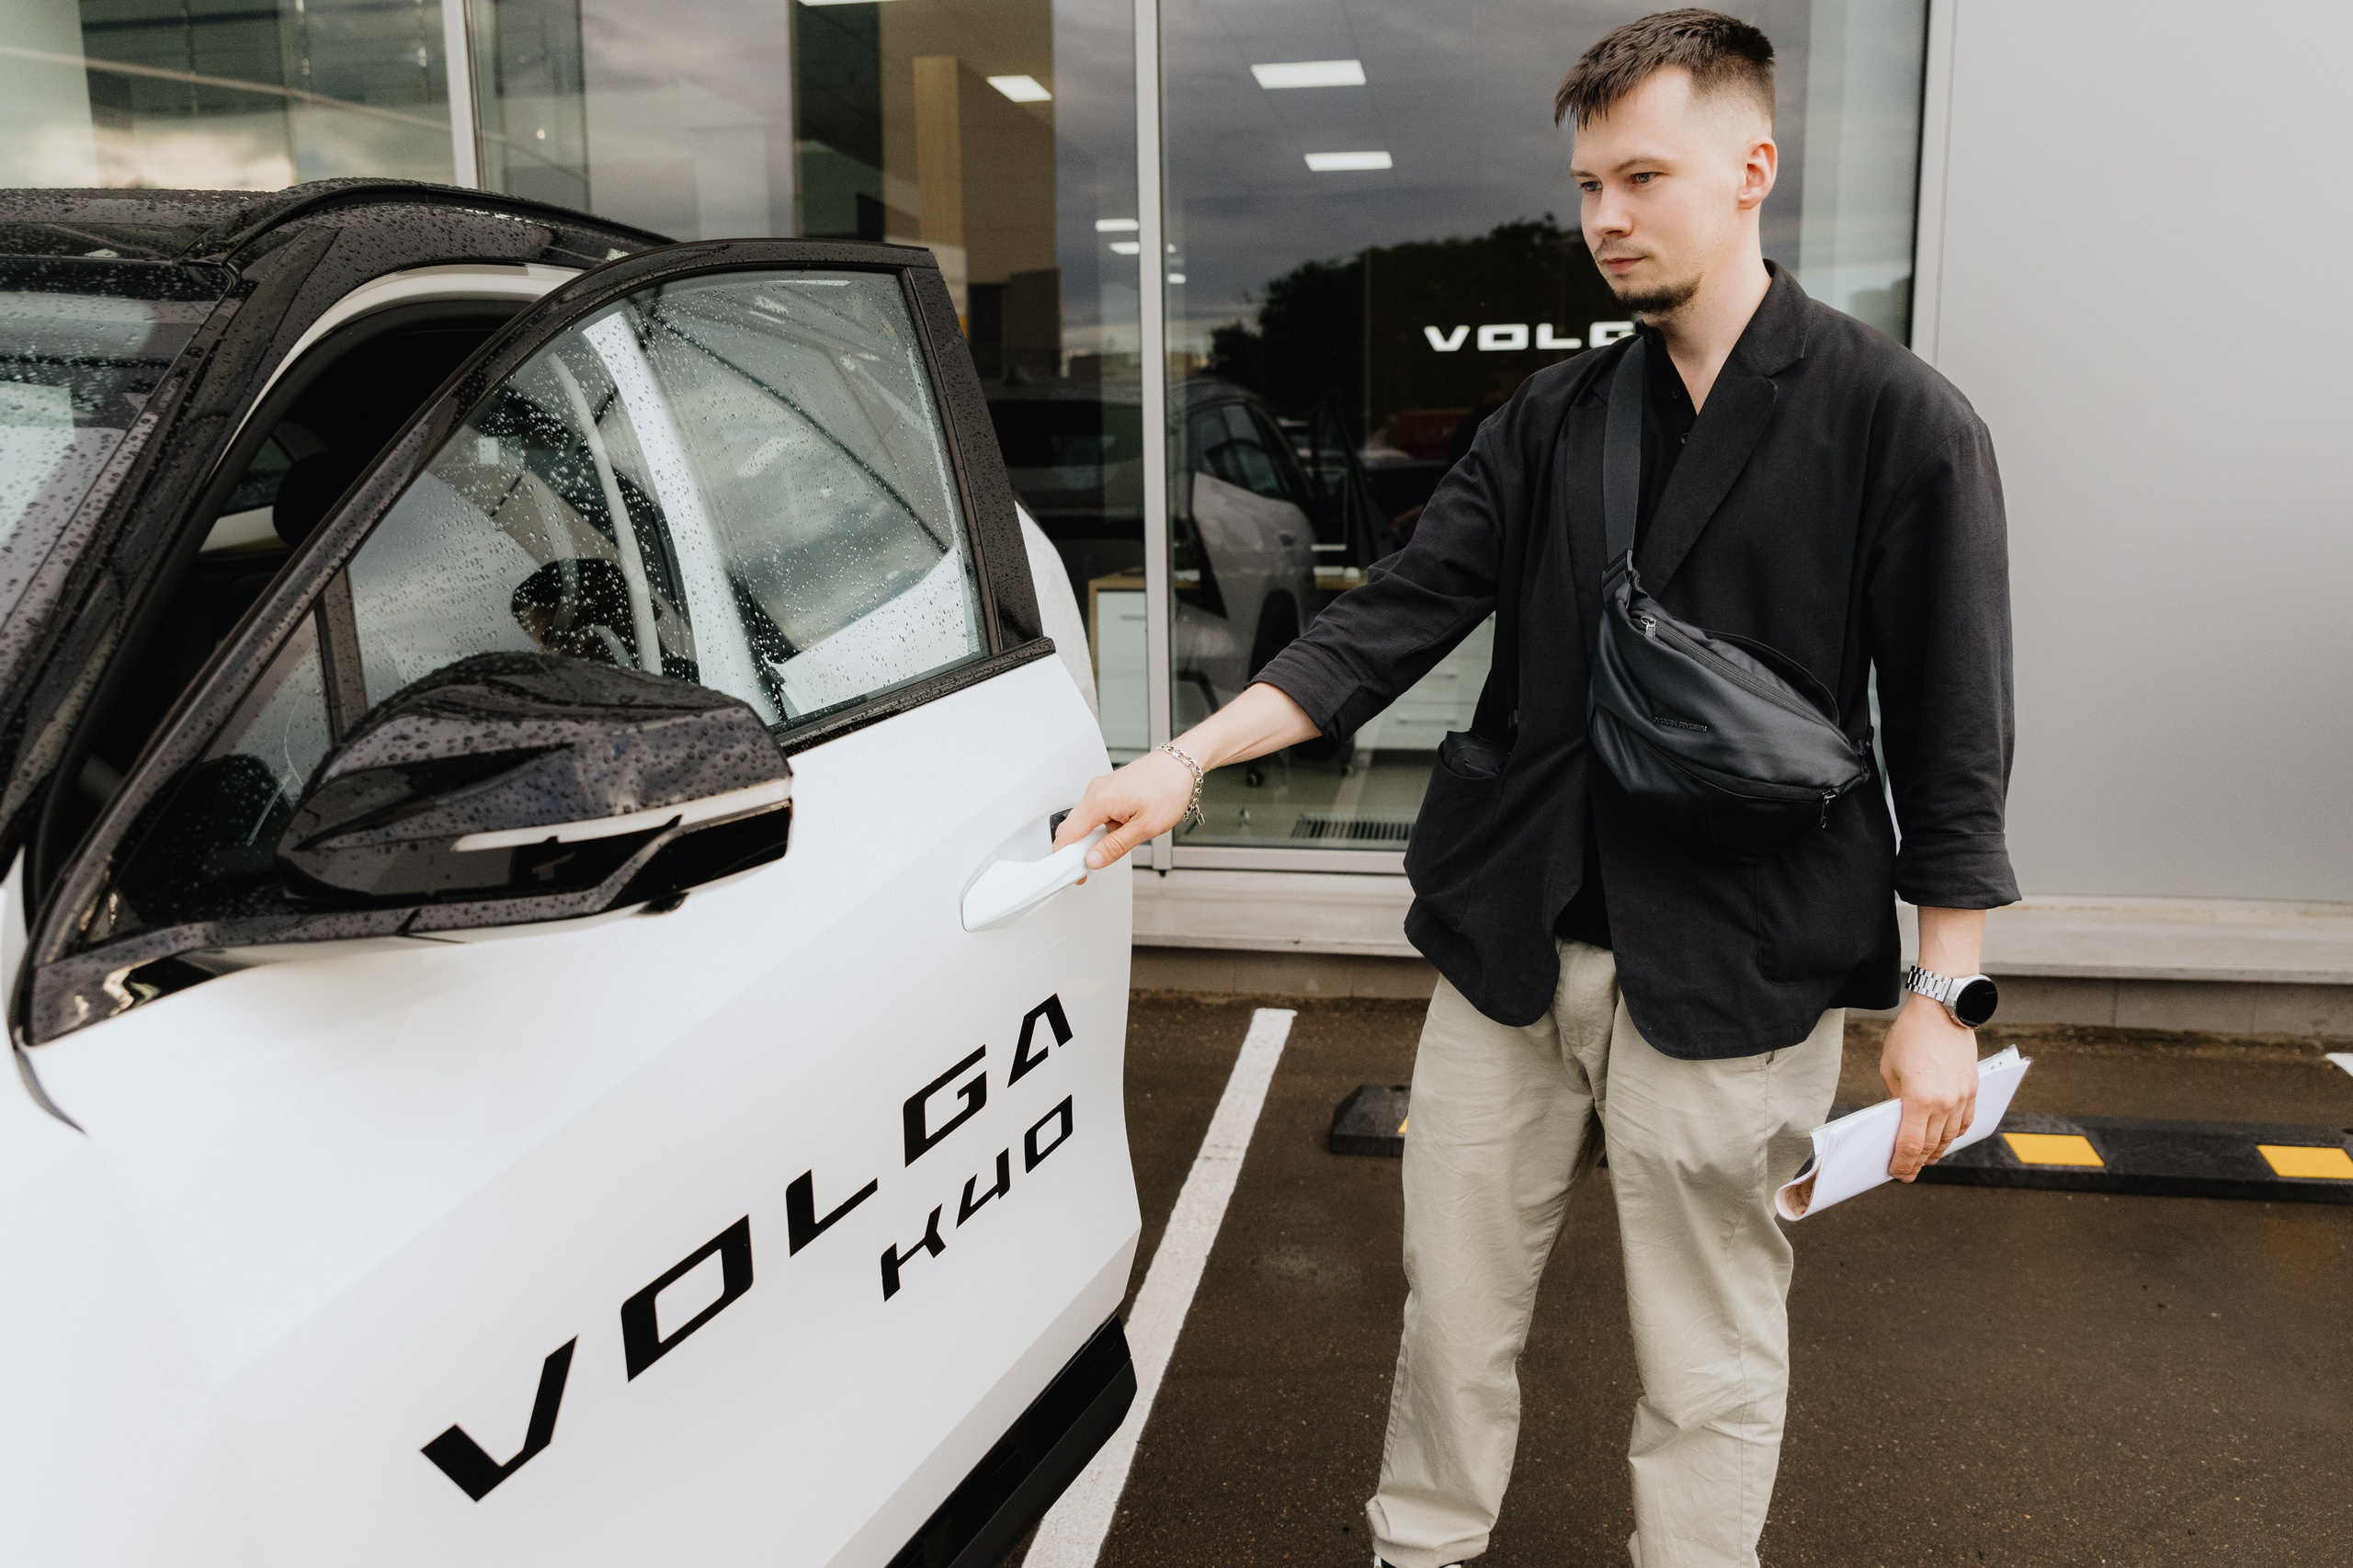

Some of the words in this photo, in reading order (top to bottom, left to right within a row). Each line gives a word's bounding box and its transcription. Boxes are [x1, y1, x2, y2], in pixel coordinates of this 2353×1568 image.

[1424, 321, 1634, 351] VOLG
[421, 992, 1073, 1502] VOLGA
[881, 1094, 1074, 1302] K40
